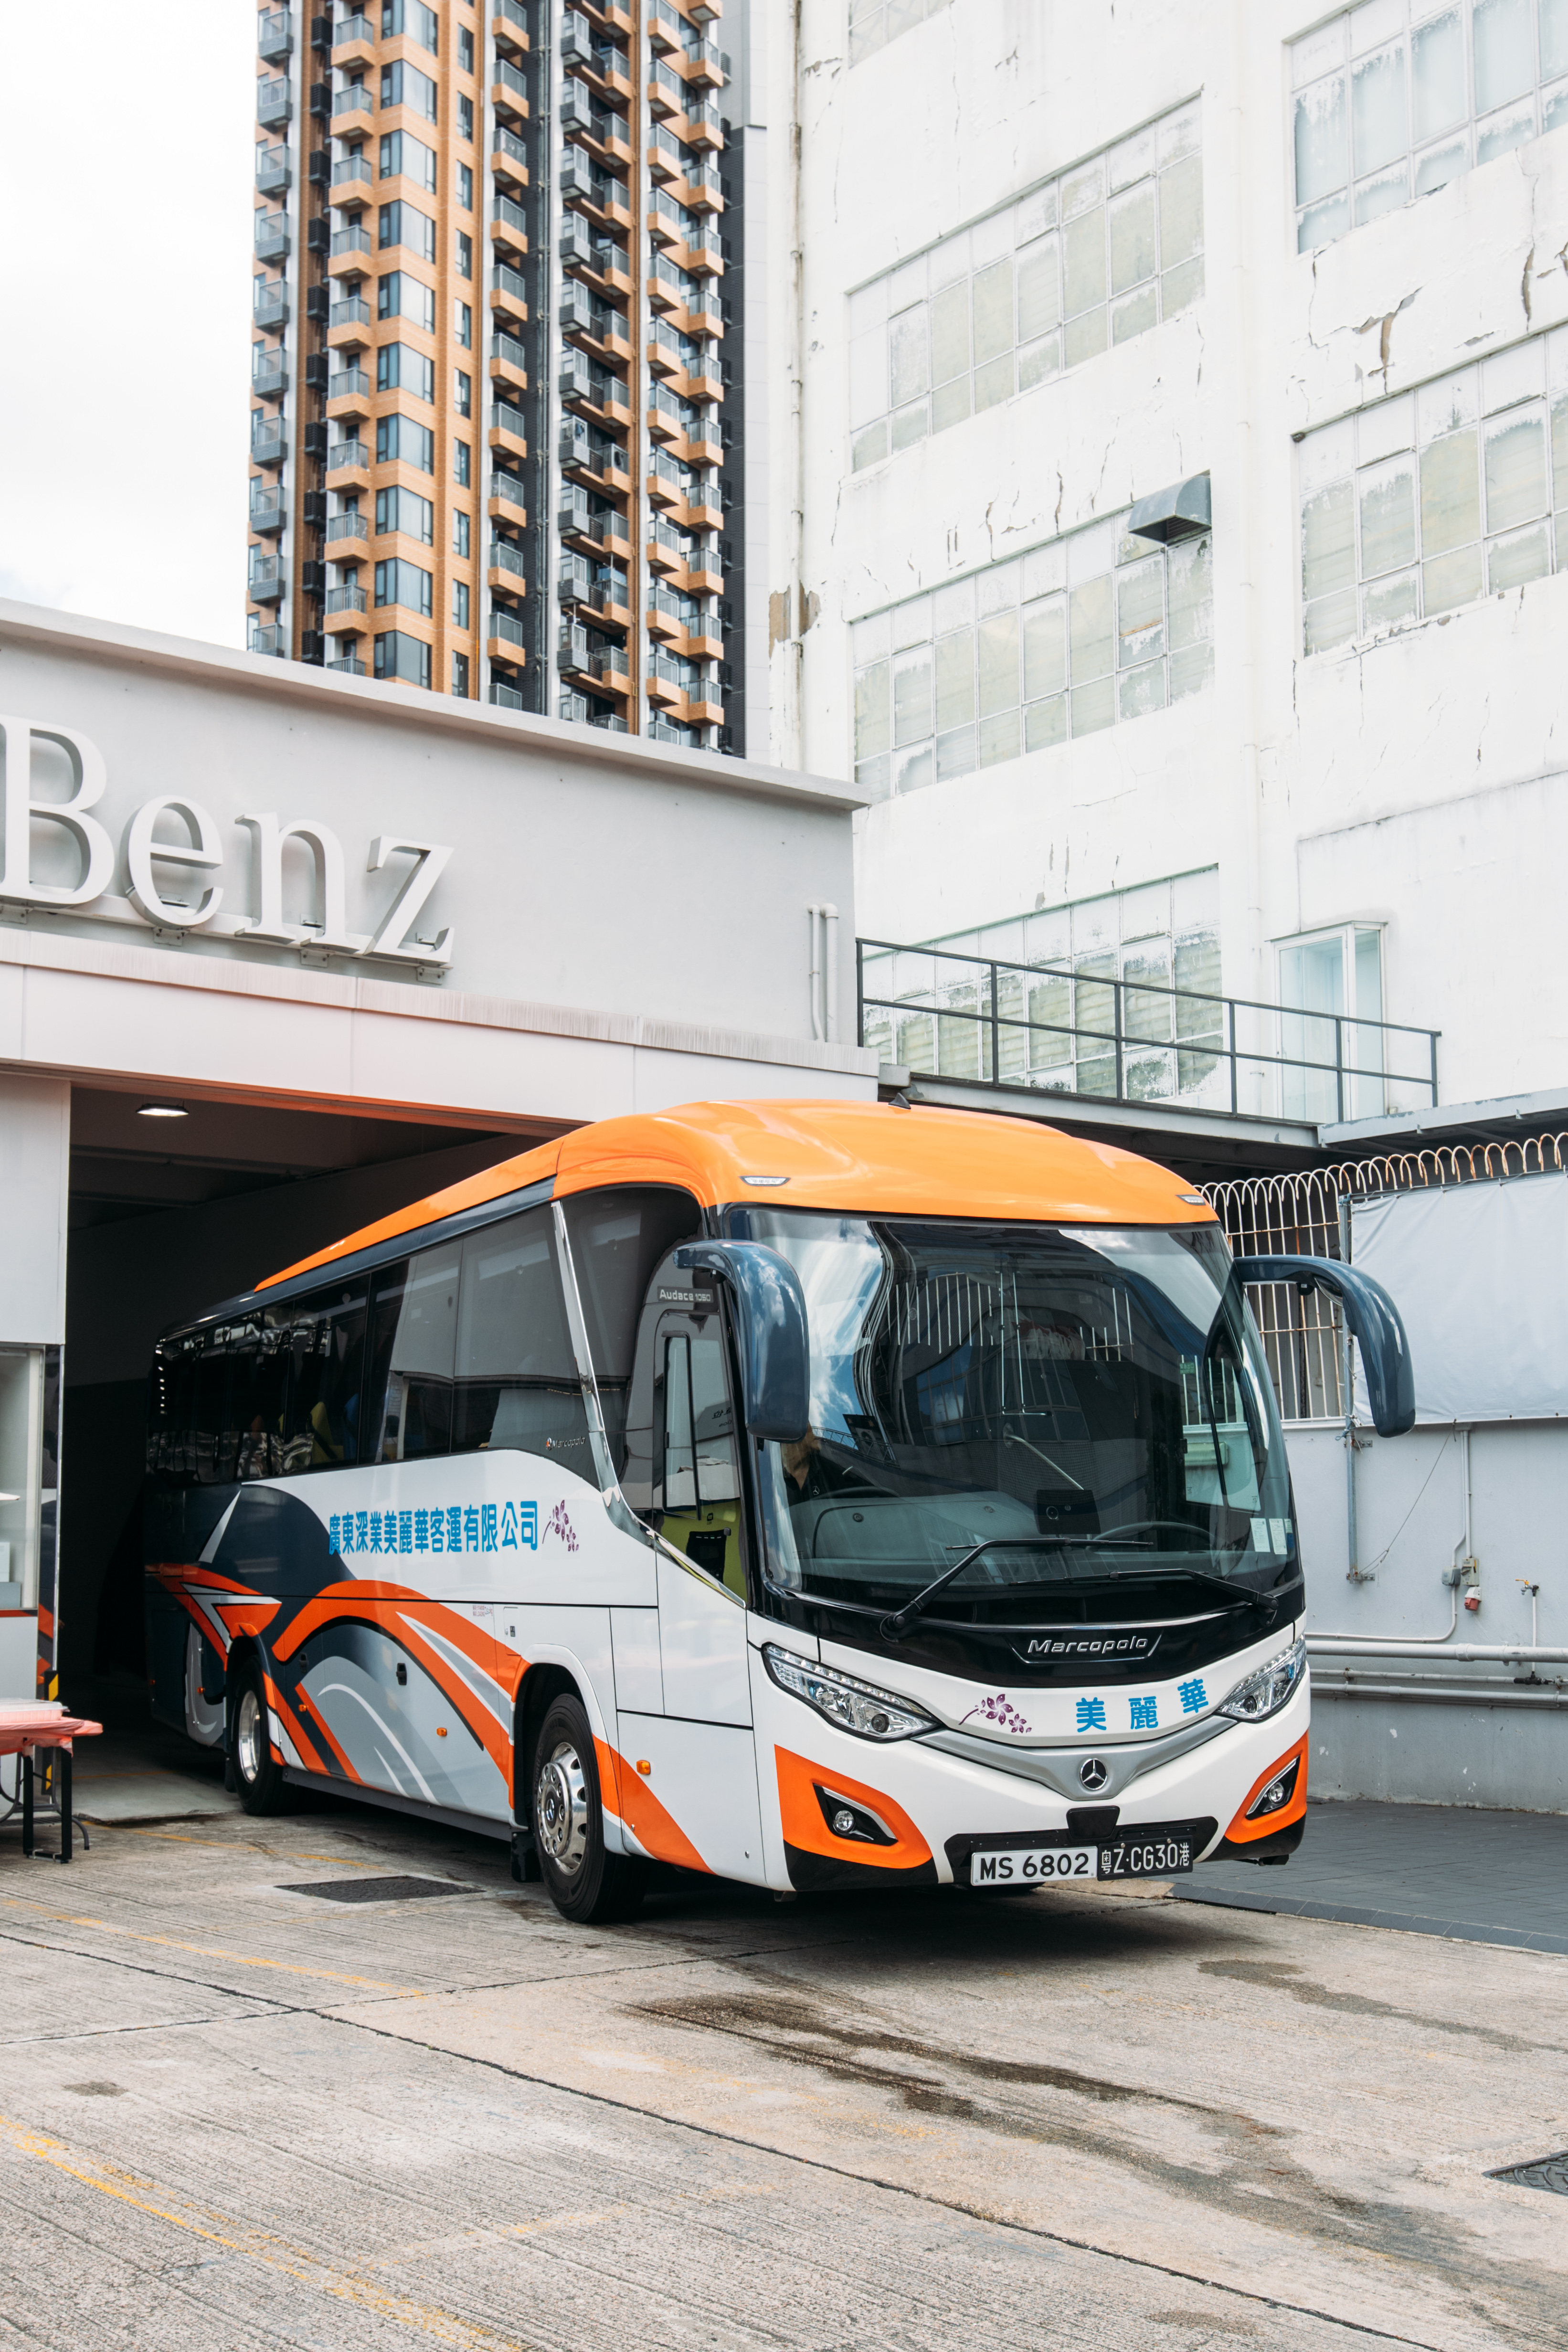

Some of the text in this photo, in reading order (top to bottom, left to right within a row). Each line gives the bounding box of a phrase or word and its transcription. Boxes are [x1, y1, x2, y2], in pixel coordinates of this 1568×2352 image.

[0, 715, 455, 966] Benz
[659, 1289, 711, 1302] Audace 1050
[551, 1436, 585, 1448] Marcopolo
[328, 1501, 538, 1555] 廣東深業美麗華客運有限公司
[1028, 1636, 1148, 1654] Marcopolo
[1076, 1678, 1209, 1733] 美麗華
[980, 1853, 1089, 1880] MS 6802
